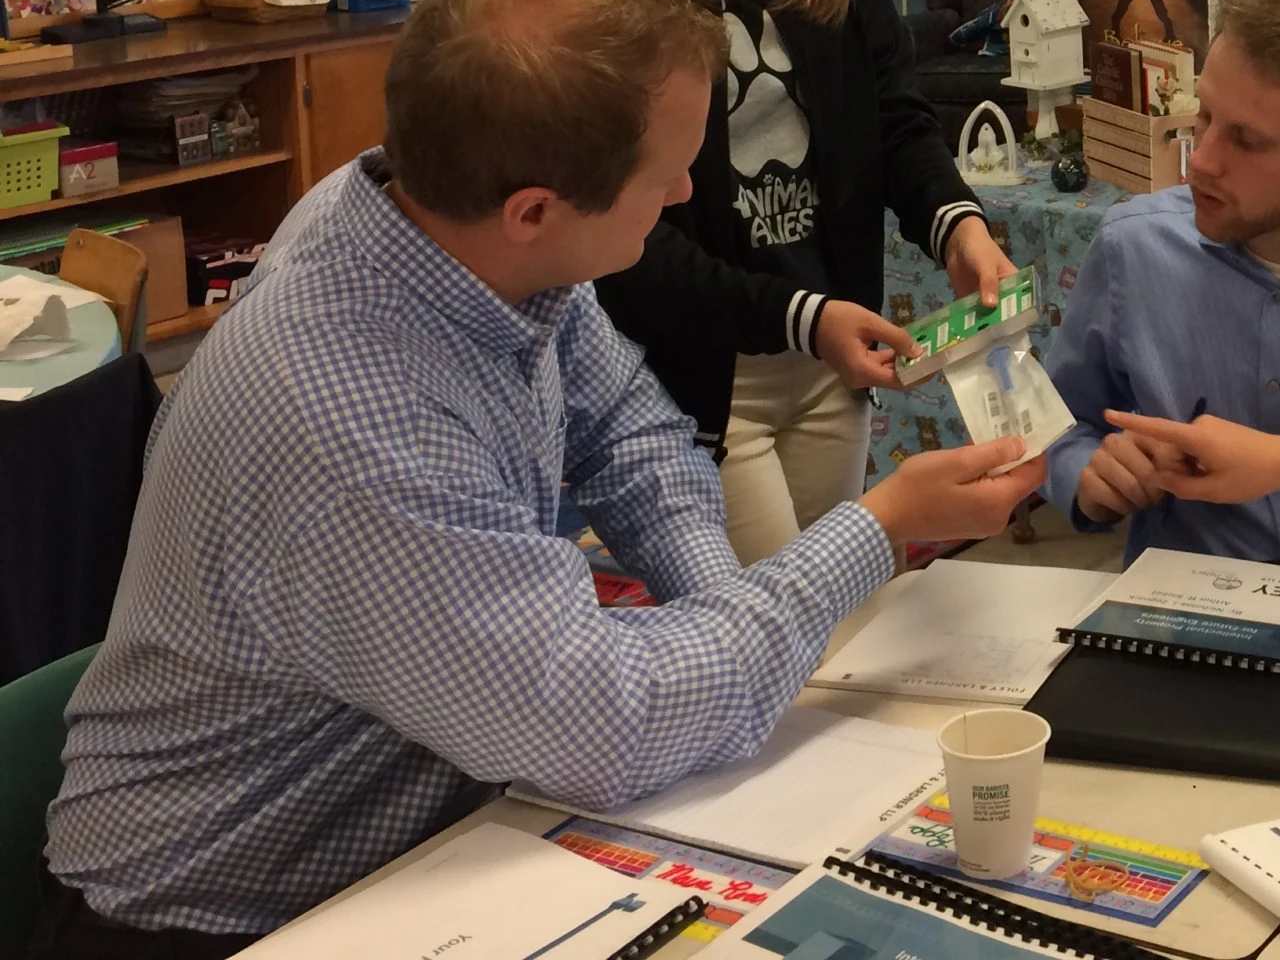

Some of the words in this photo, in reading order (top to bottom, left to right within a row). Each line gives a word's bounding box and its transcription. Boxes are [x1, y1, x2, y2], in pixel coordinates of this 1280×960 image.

[69, 161, 97, 184] A2
[1133, 617, 1184, 631] Property
[1141, 612, 1198, 626] Engineers
[1201, 620, 1240, 632] Future
[1185, 626, 1253, 641] Intellectual
[1242, 626, 1259, 634] for
[894, 783, 932, 810] LARDNER
[972, 791, 1010, 800] PROMISE
[878, 809, 897, 822] LLP
[432, 934, 473, 957] Your
